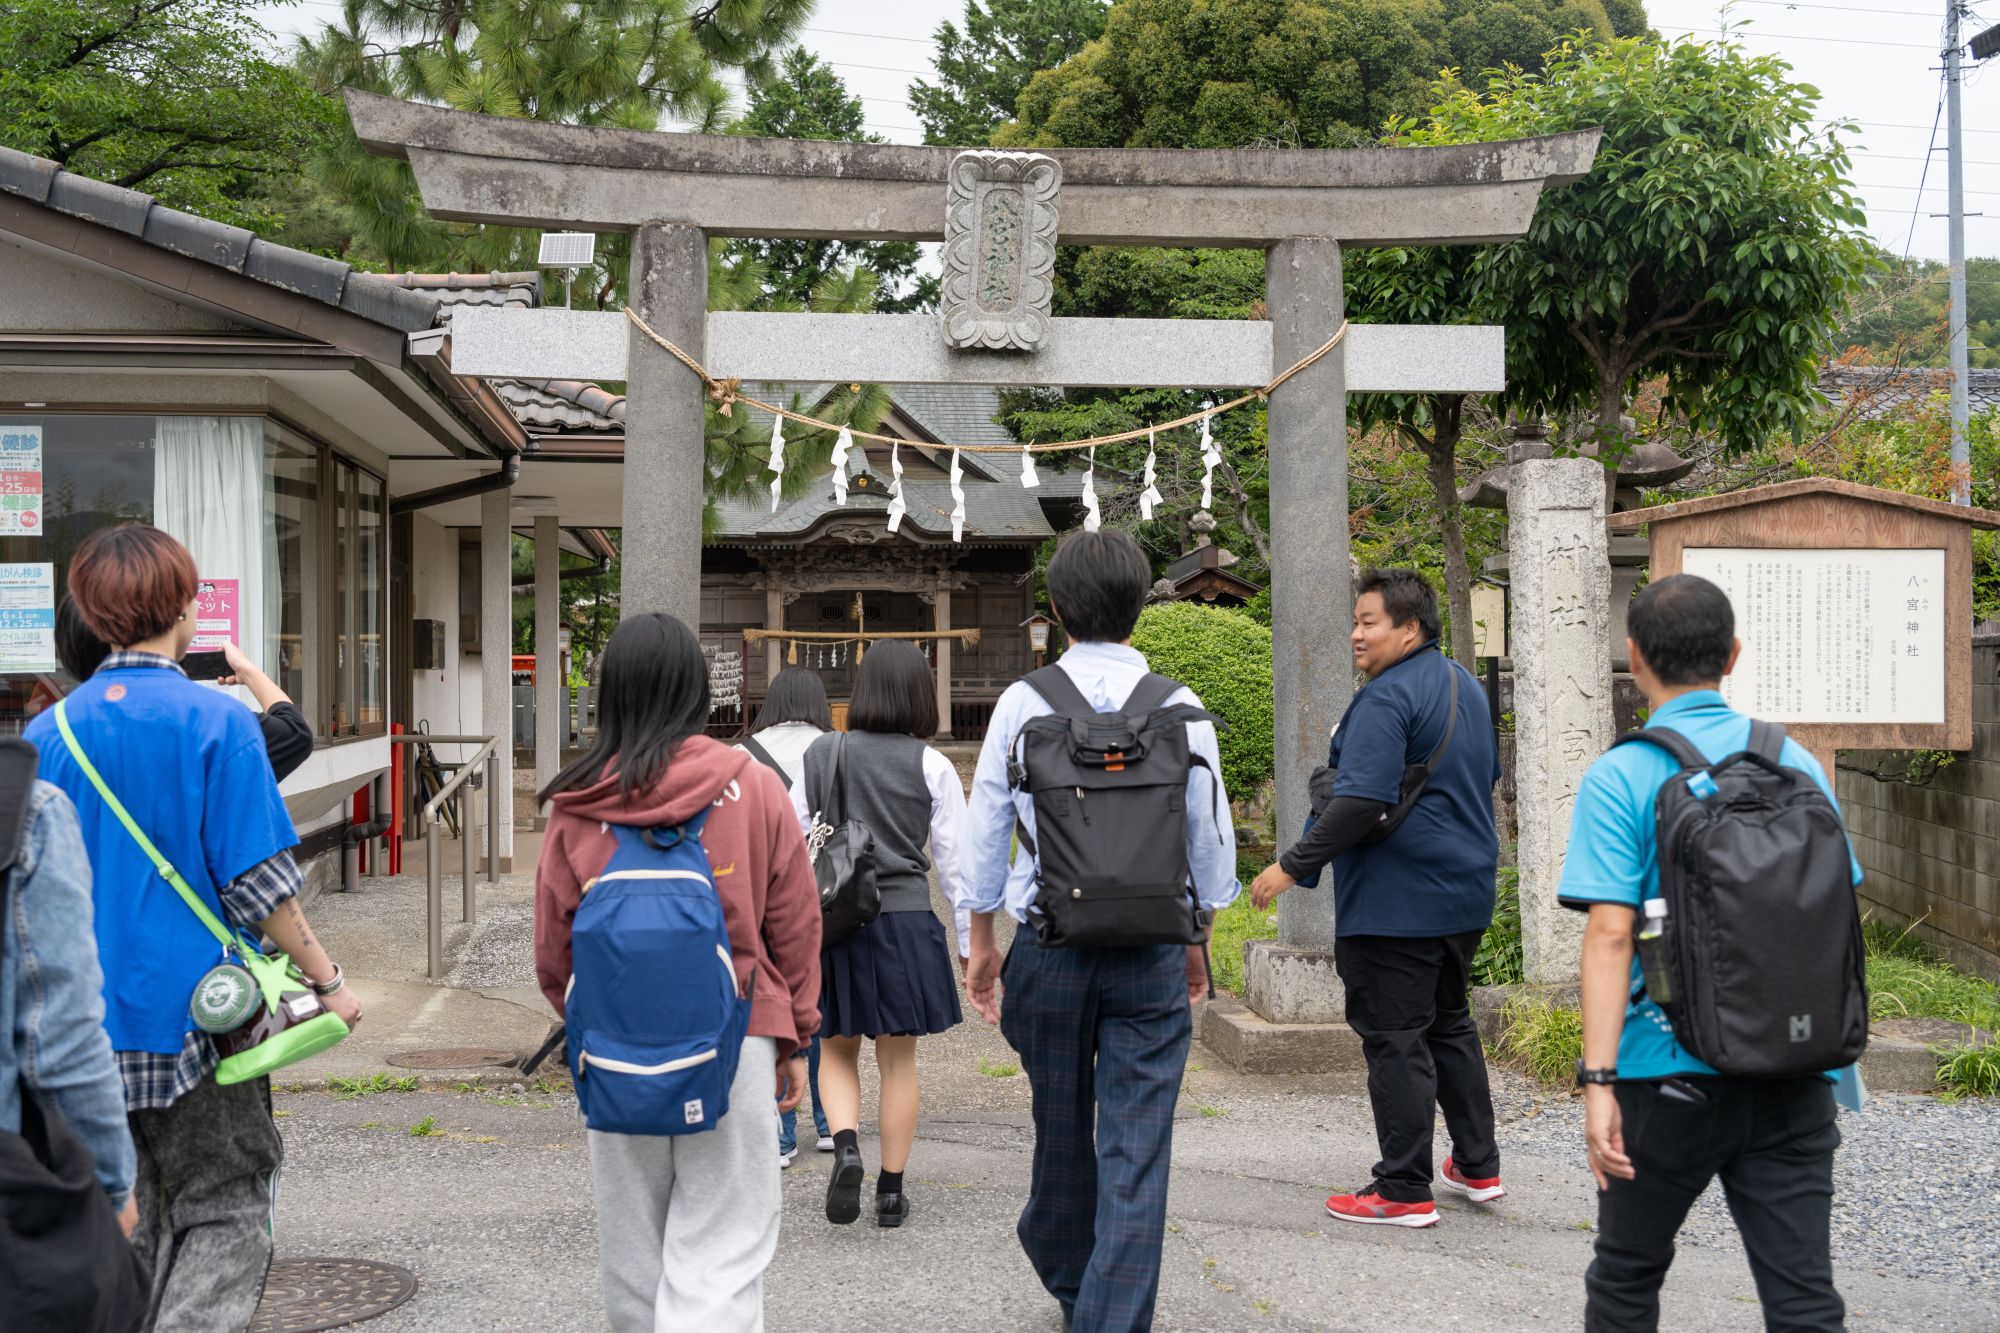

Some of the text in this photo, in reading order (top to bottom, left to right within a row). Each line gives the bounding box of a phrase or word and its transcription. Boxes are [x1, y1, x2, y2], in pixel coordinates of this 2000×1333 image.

[0, 433, 39, 451] 健診
[1906, 575, 1919, 657] 八宮神社
